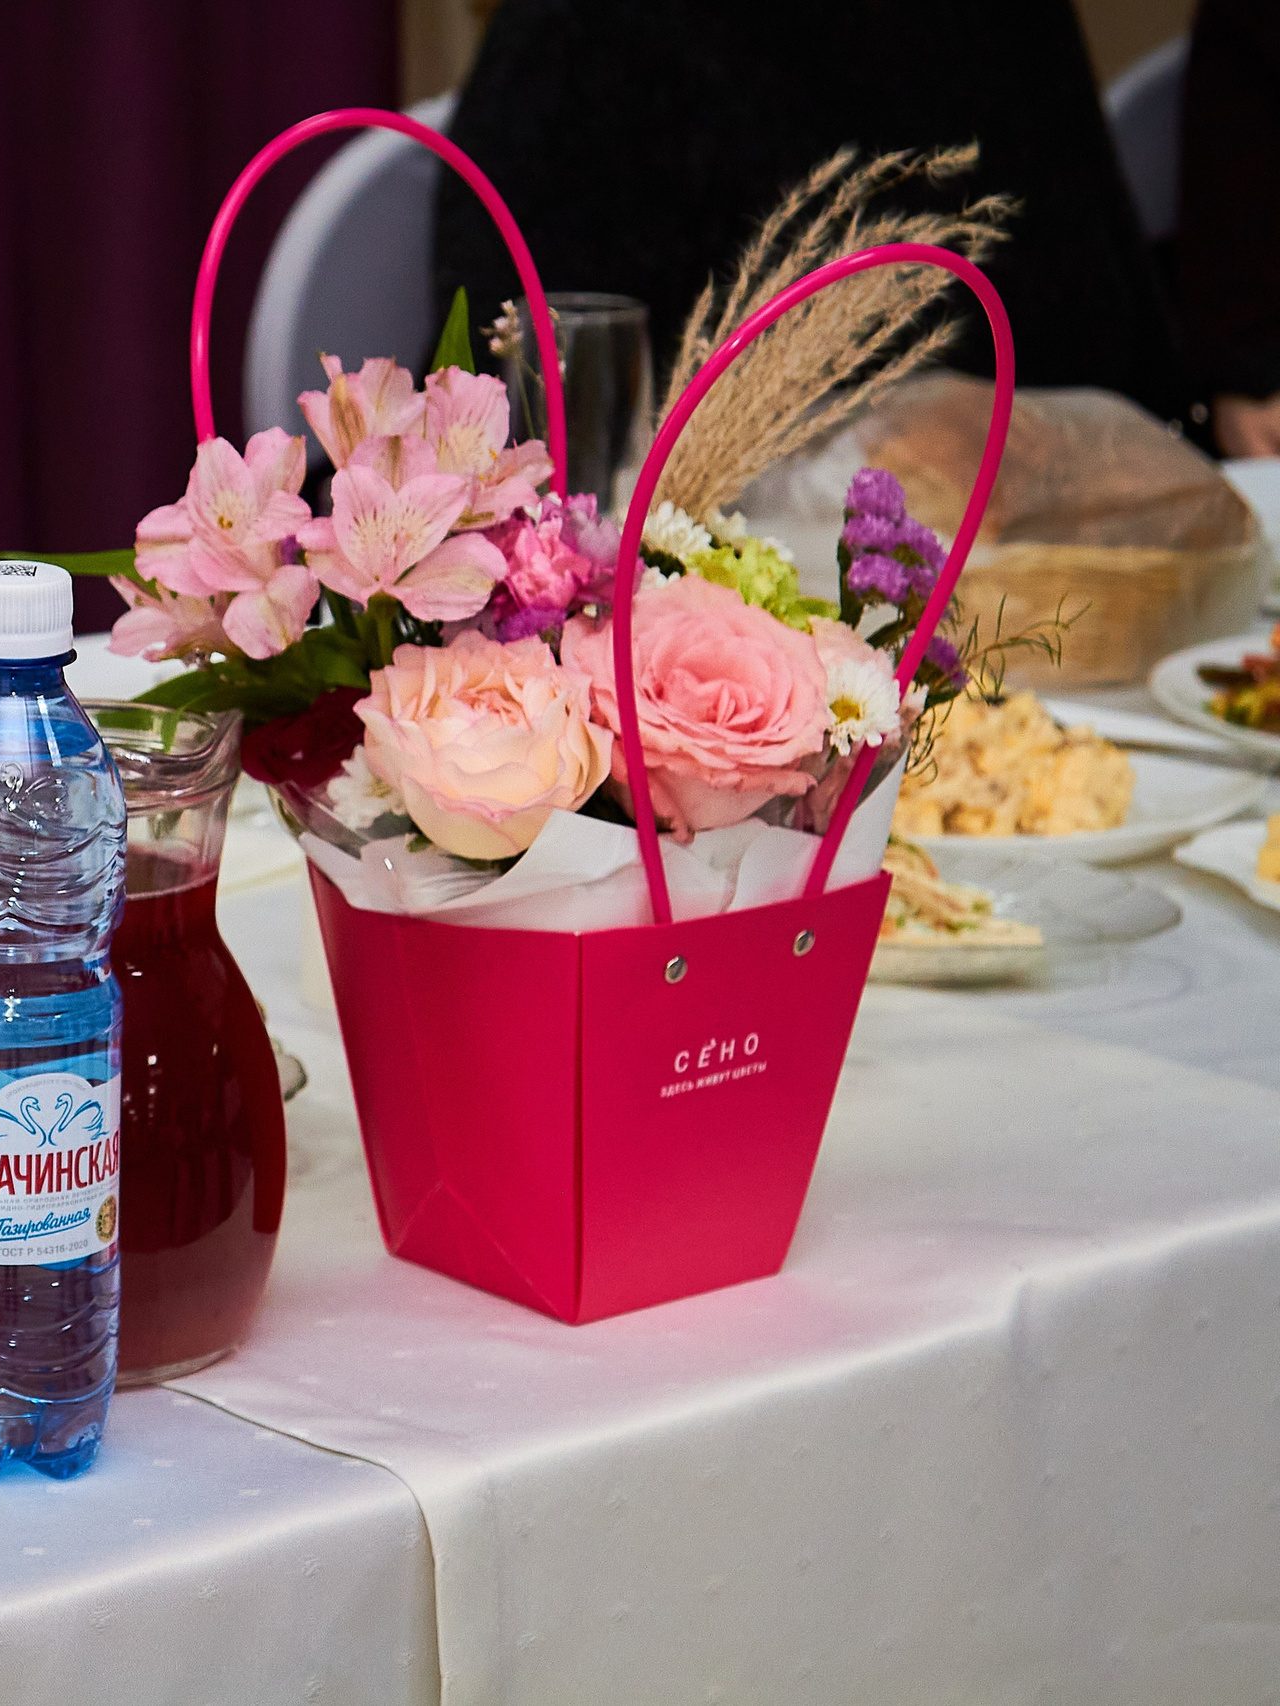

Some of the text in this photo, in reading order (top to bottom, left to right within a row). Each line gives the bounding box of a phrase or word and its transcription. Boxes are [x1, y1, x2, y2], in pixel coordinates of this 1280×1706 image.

[659, 1060, 768, 1099] ЗДЕСЬ ЖИВУТ ЦВЕТЫ
[27, 1247, 34, 1255] Р
[36, 1240, 89, 1256] 54316-2020
